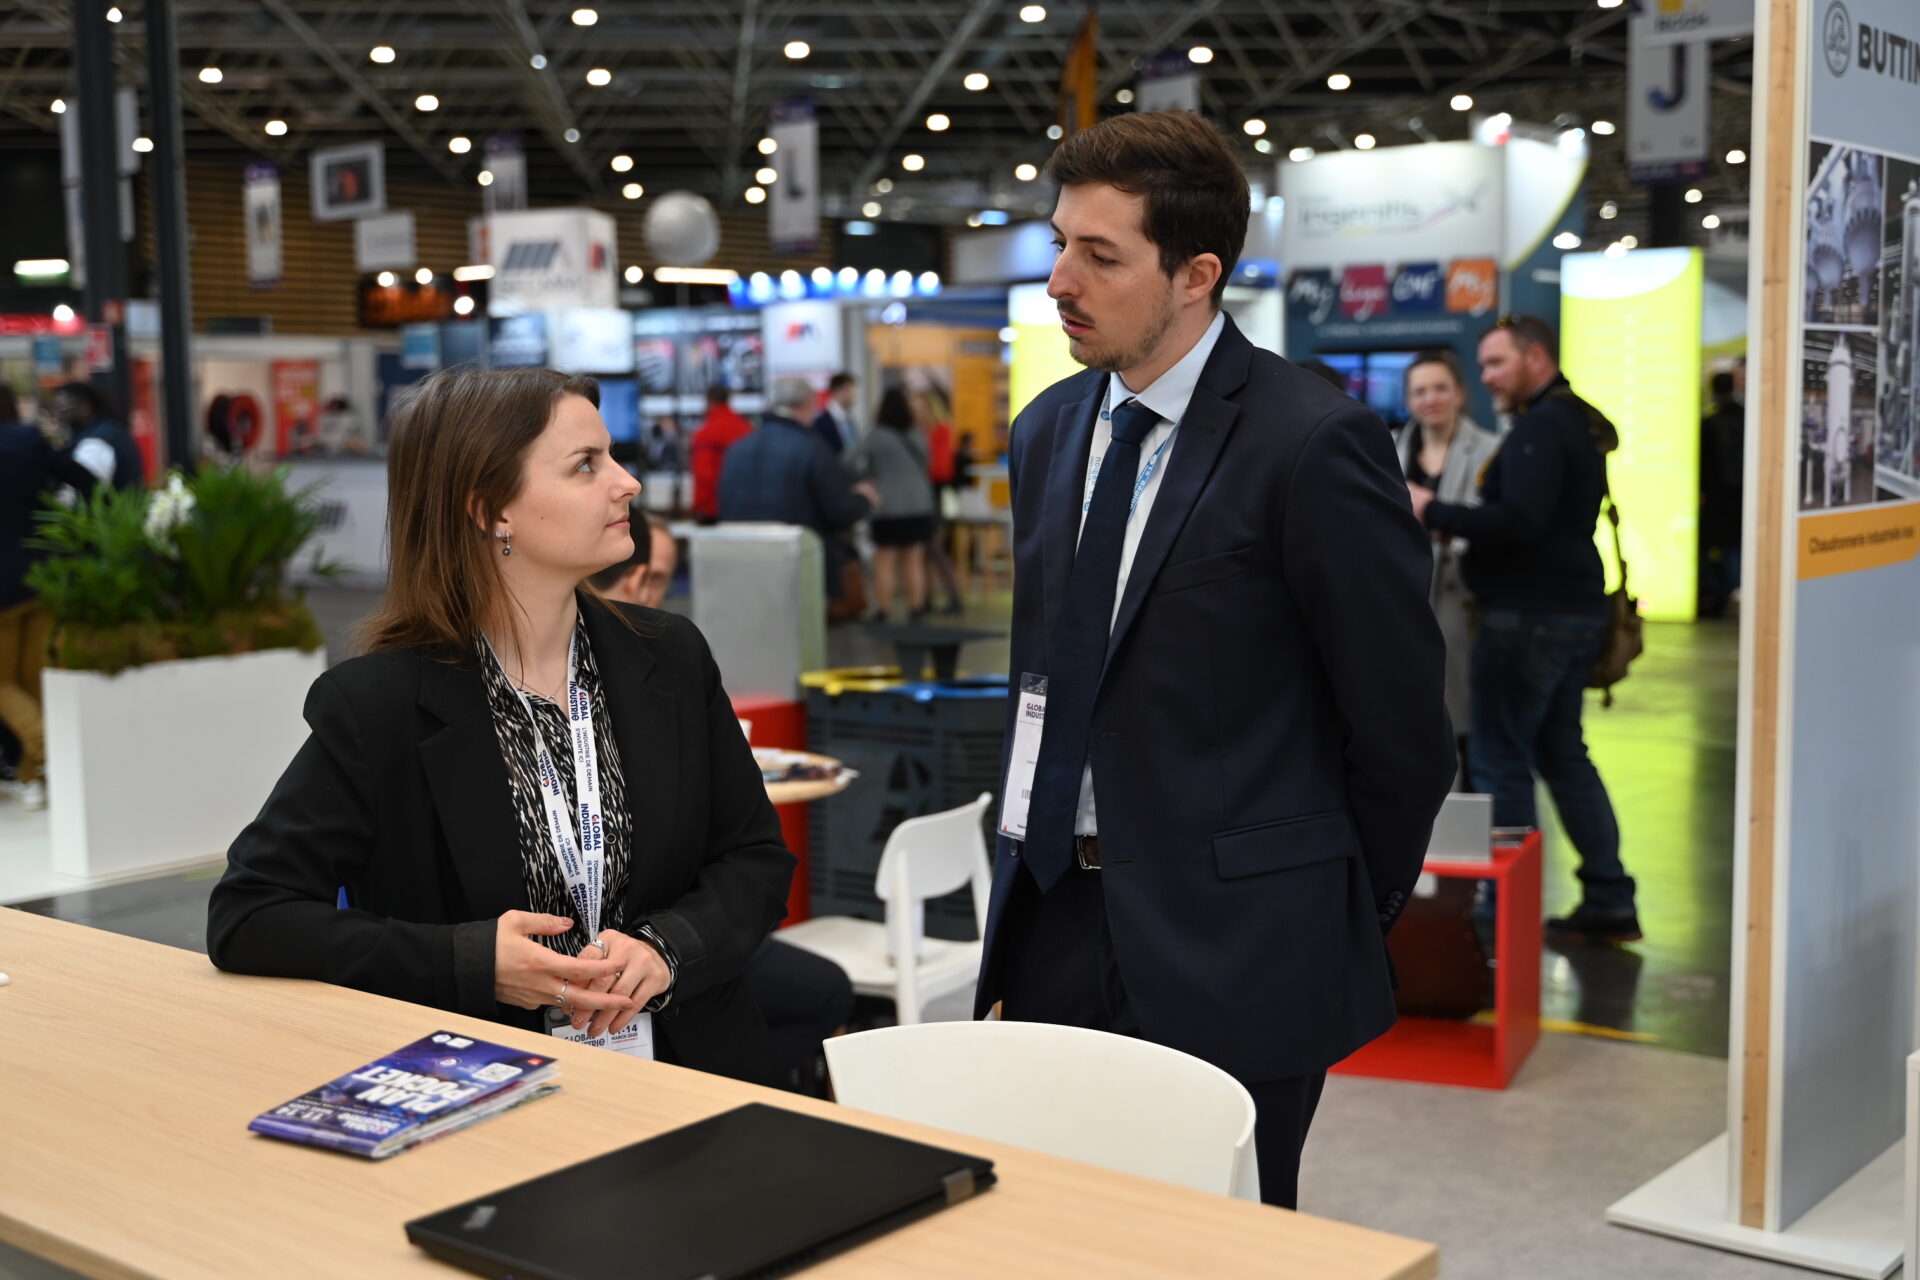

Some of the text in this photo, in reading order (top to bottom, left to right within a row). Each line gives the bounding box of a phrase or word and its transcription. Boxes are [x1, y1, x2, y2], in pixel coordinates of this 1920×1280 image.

[579, 691, 589, 721] GLOBAL
[591, 814, 602, 851] GLOBAL
[351, 1065, 480, 1101] POCKET
[355, 1085, 450, 1114] PLAN
